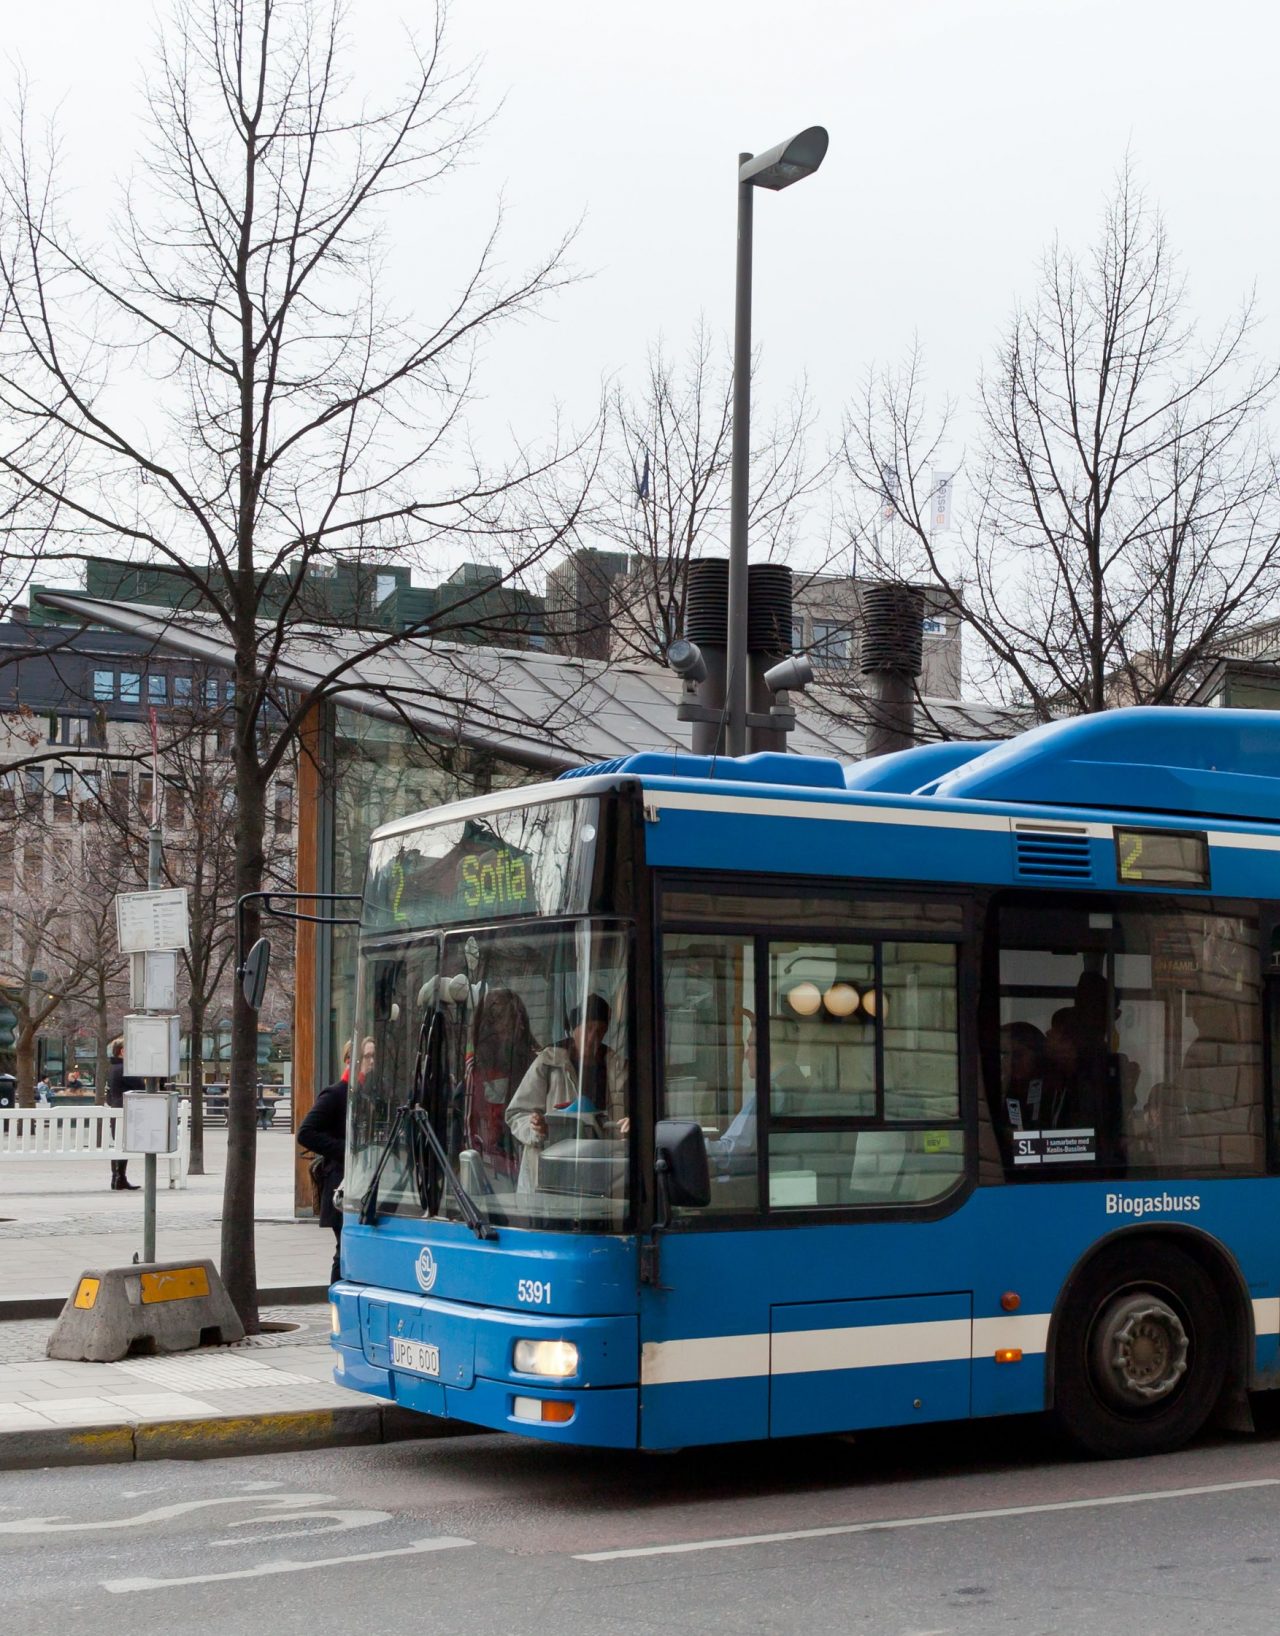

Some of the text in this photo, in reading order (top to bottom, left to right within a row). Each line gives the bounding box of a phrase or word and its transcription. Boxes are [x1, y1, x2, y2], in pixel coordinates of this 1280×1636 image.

[1120, 833, 1143, 880] 2
[391, 861, 408, 923] 2
[462, 849, 527, 907] Sofia
[1018, 1140, 1036, 1155] SL
[1106, 1192, 1200, 1217] Biogasbuss
[421, 1255, 432, 1272] SL
[518, 1279, 551, 1305] 5391
[395, 1342, 437, 1372] UPG 600
